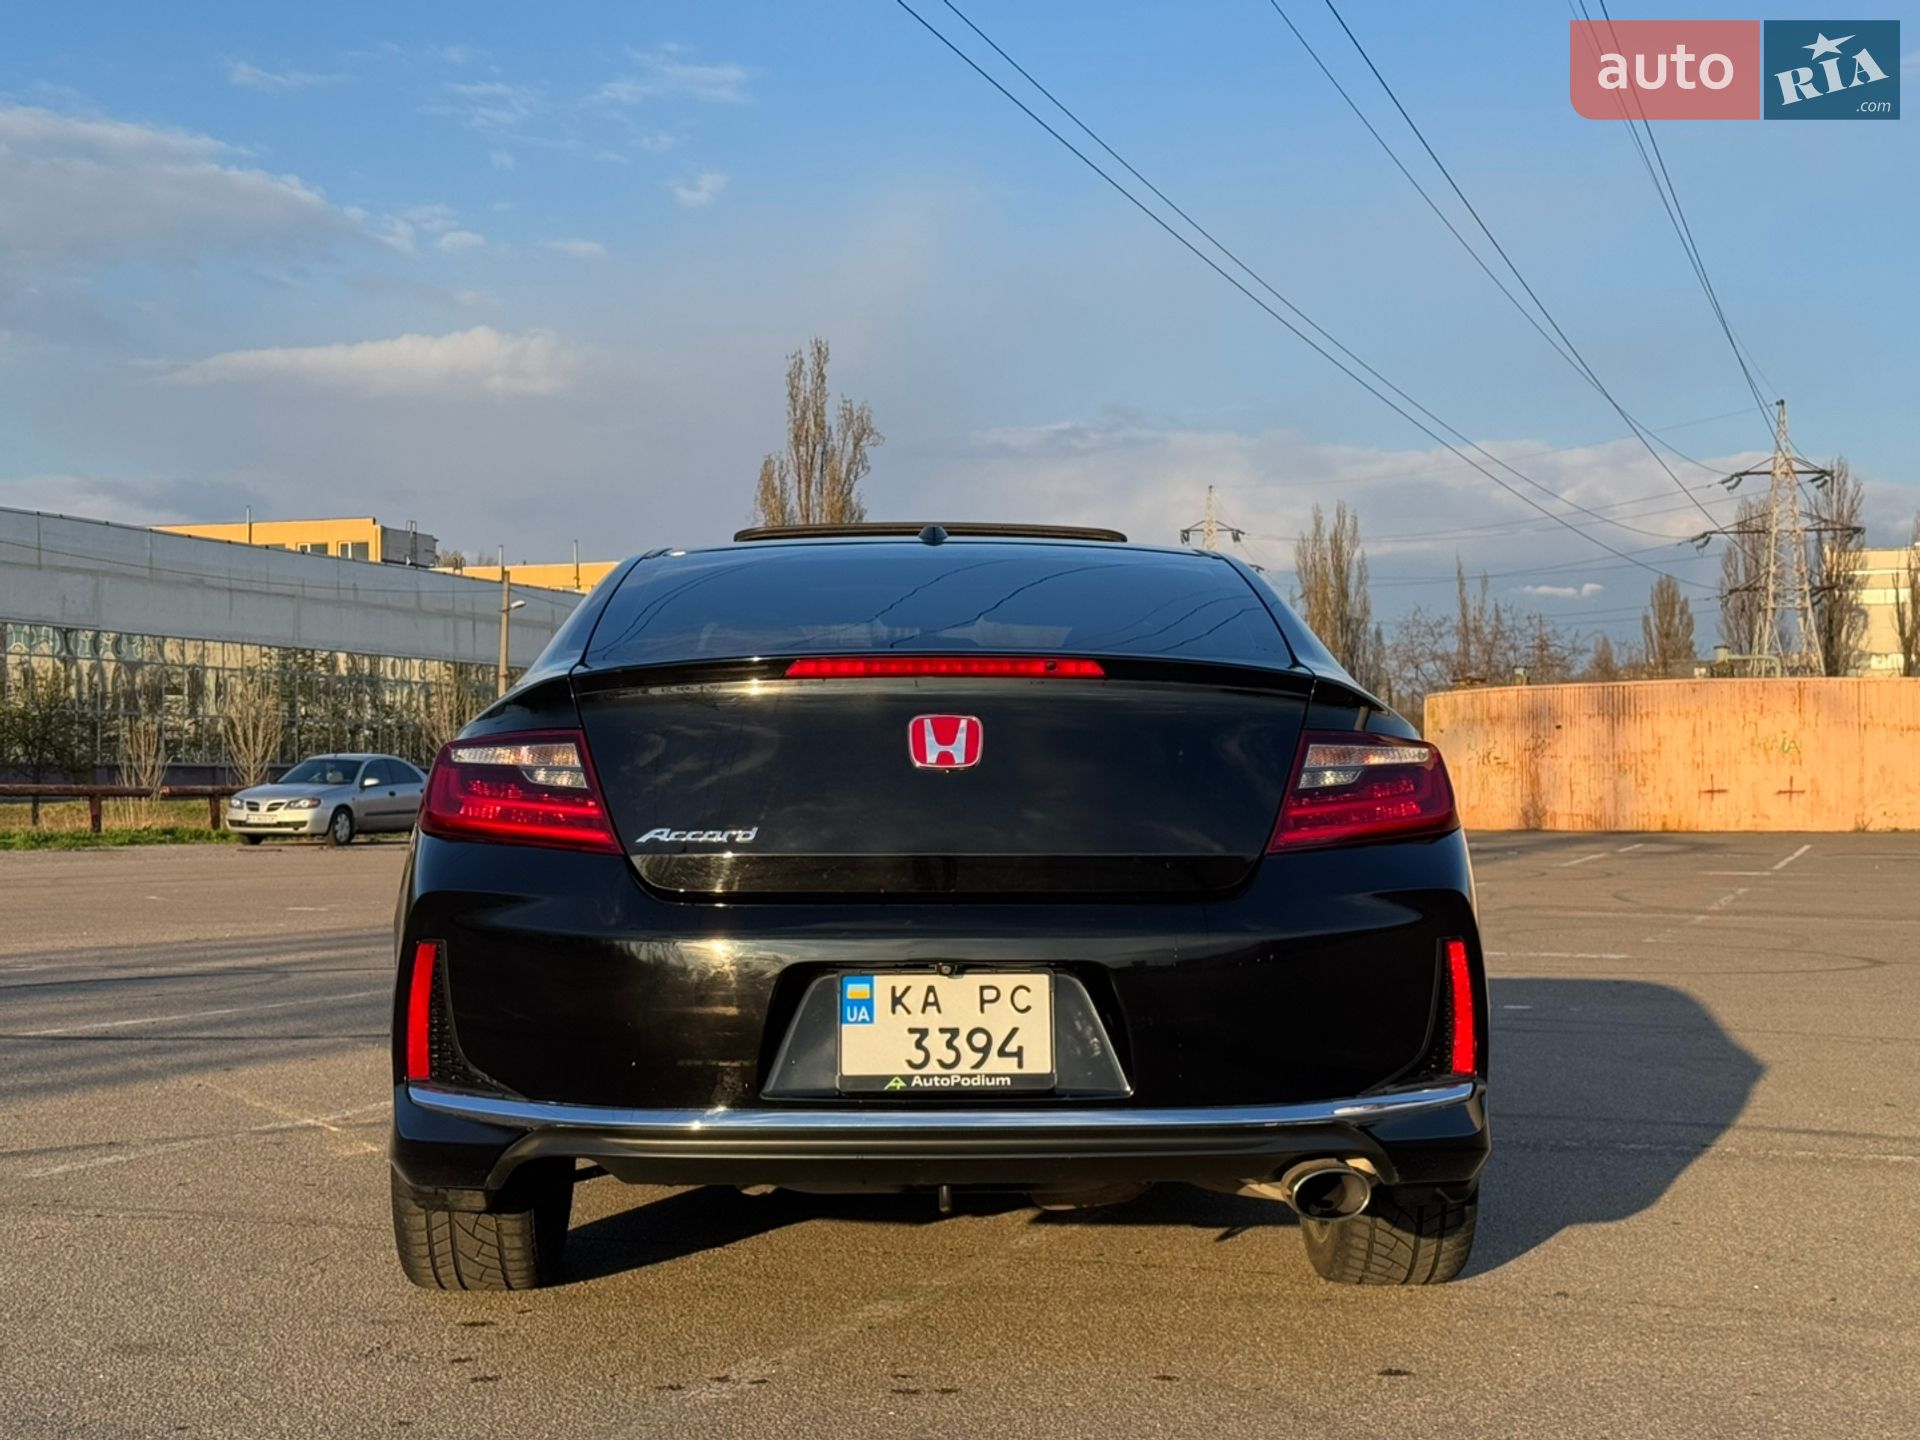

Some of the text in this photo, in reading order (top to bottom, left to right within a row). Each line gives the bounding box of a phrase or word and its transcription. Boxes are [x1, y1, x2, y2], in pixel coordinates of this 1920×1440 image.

[635, 826, 759, 843] Accord
[890, 985, 1032, 1015] KA PC
[847, 1006, 870, 1022] UA
[905, 1027, 1024, 1070] 3394
[911, 1075, 1011, 1087] AutoPodium
